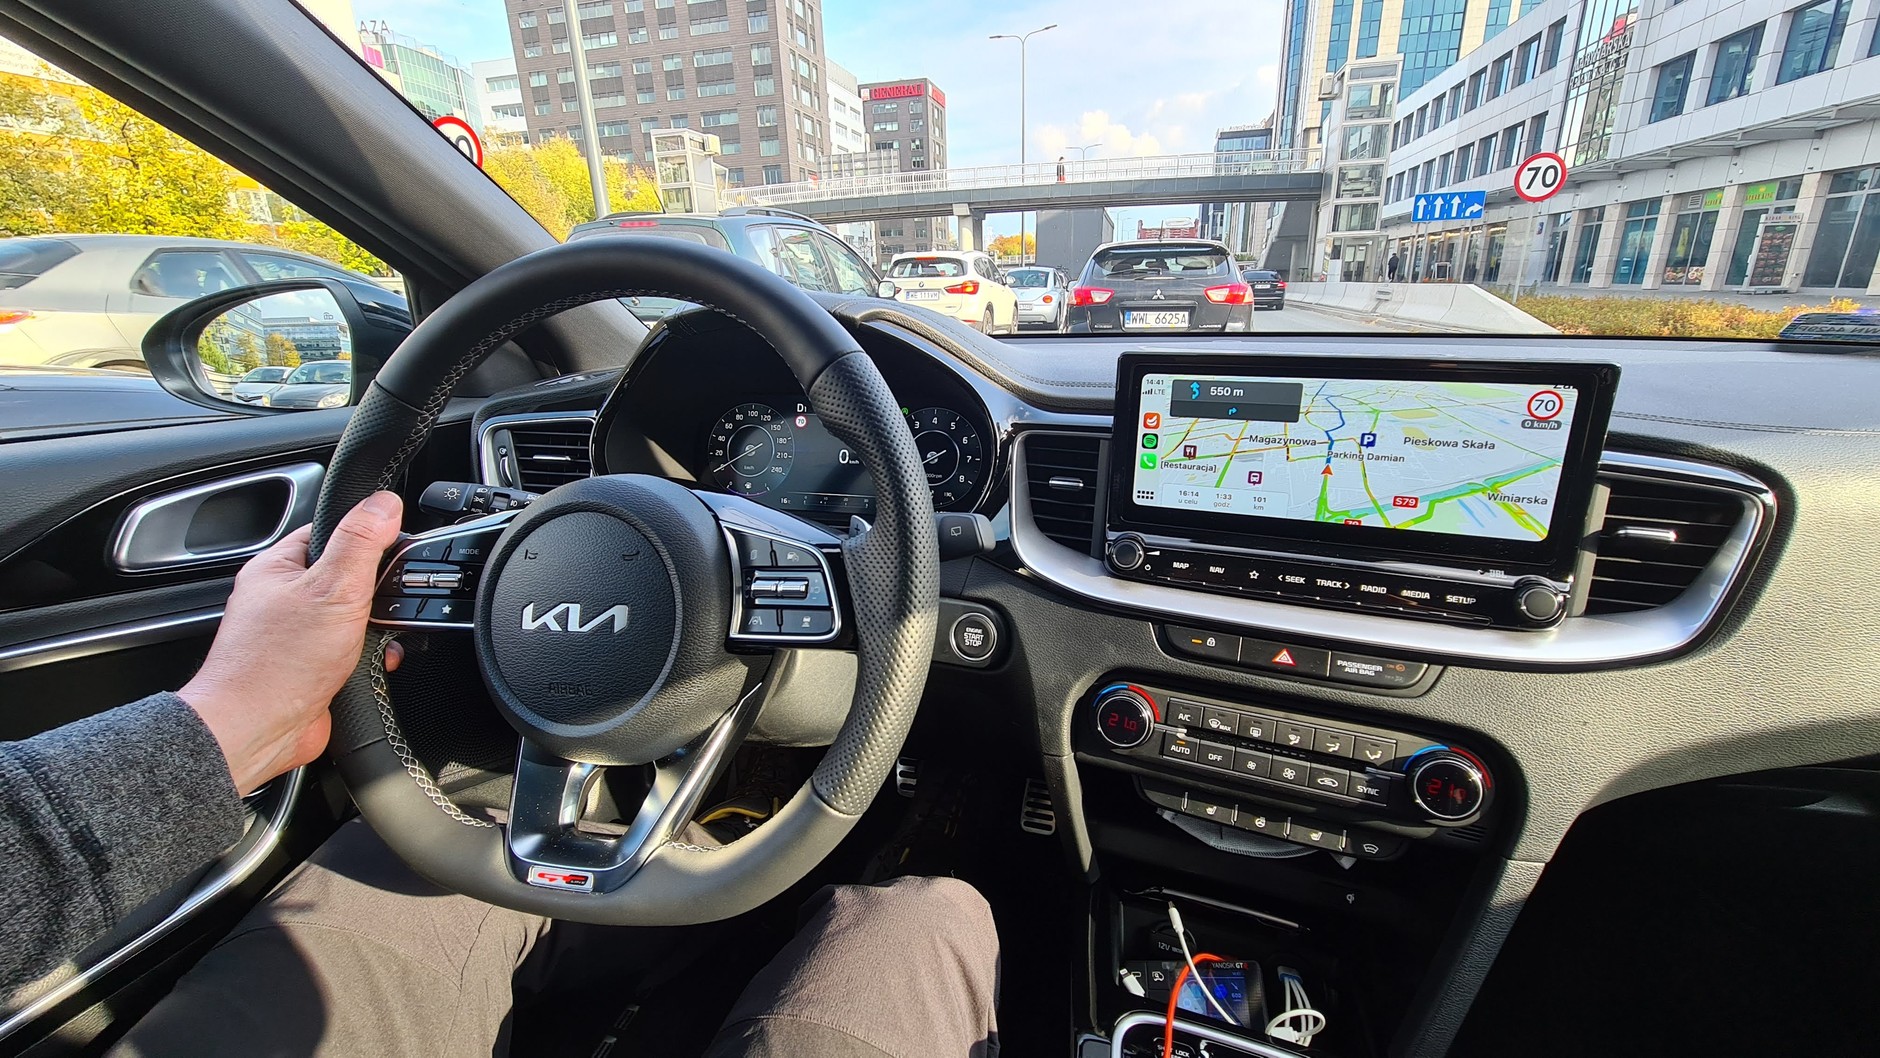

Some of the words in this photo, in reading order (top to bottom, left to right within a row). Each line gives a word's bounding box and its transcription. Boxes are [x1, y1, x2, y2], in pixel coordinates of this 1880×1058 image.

[872, 83, 925, 100] GENERALI
[1525, 164, 1559, 190] 70
[1131, 312, 1151, 324] WWL
[1154, 312, 1187, 325] 6625A
[1210, 386, 1231, 396] 550
[1233, 389, 1244, 397] m
[1534, 399, 1556, 412] 70
[914, 421, 920, 429] 3
[931, 417, 938, 425] 4
[950, 422, 956, 430] 5
[1524, 420, 1532, 428] 0
[1533, 421, 1558, 430] km/h
[962, 436, 968, 444] 6
[1249, 434, 1317, 447] Magazynowa
[1403, 436, 1459, 449] Pieskowa
[1461, 439, 1496, 450] Skała
[838, 449, 850, 464] 0
[966, 455, 972, 463] 7
[1327, 451, 1365, 463] Parking
[1366, 453, 1405, 463] Damian
[1160, 461, 1217, 473] [Restauracja]
[959, 475, 965, 483] 8
[1178, 490, 1199, 498] 16:14
[1216, 493, 1232, 501] 1:33
[1487, 492, 1549, 505] Winiarska
[1395, 497, 1416, 507] S79
[1172, 561, 1190, 570] MAP
[1209, 565, 1225, 574] NAV
[1285, 574, 1306, 584] SEEK
[1316, 578, 1343, 589] TRACK
[1361, 584, 1387, 594] RADIO
[1400, 589, 1431, 600] MEDIA
[1445, 594, 1477, 605] SETUP
[963, 632, 984, 641] START
[964, 639, 982, 647] STOP
[1337, 659, 1383, 672] PASSENGER
[1344, 666, 1358, 674] AIR
[1177, 713, 1191, 722] A/C
[1219, 724, 1232, 732] MAX
[1170, 744, 1191, 755] AUTO
[1208, 753, 1223, 762] OFF
[1356, 785, 1380, 796] SYNC
[1158, 941, 1171, 951] 12V
[1174, 1049, 1190, 1058] LOCK
